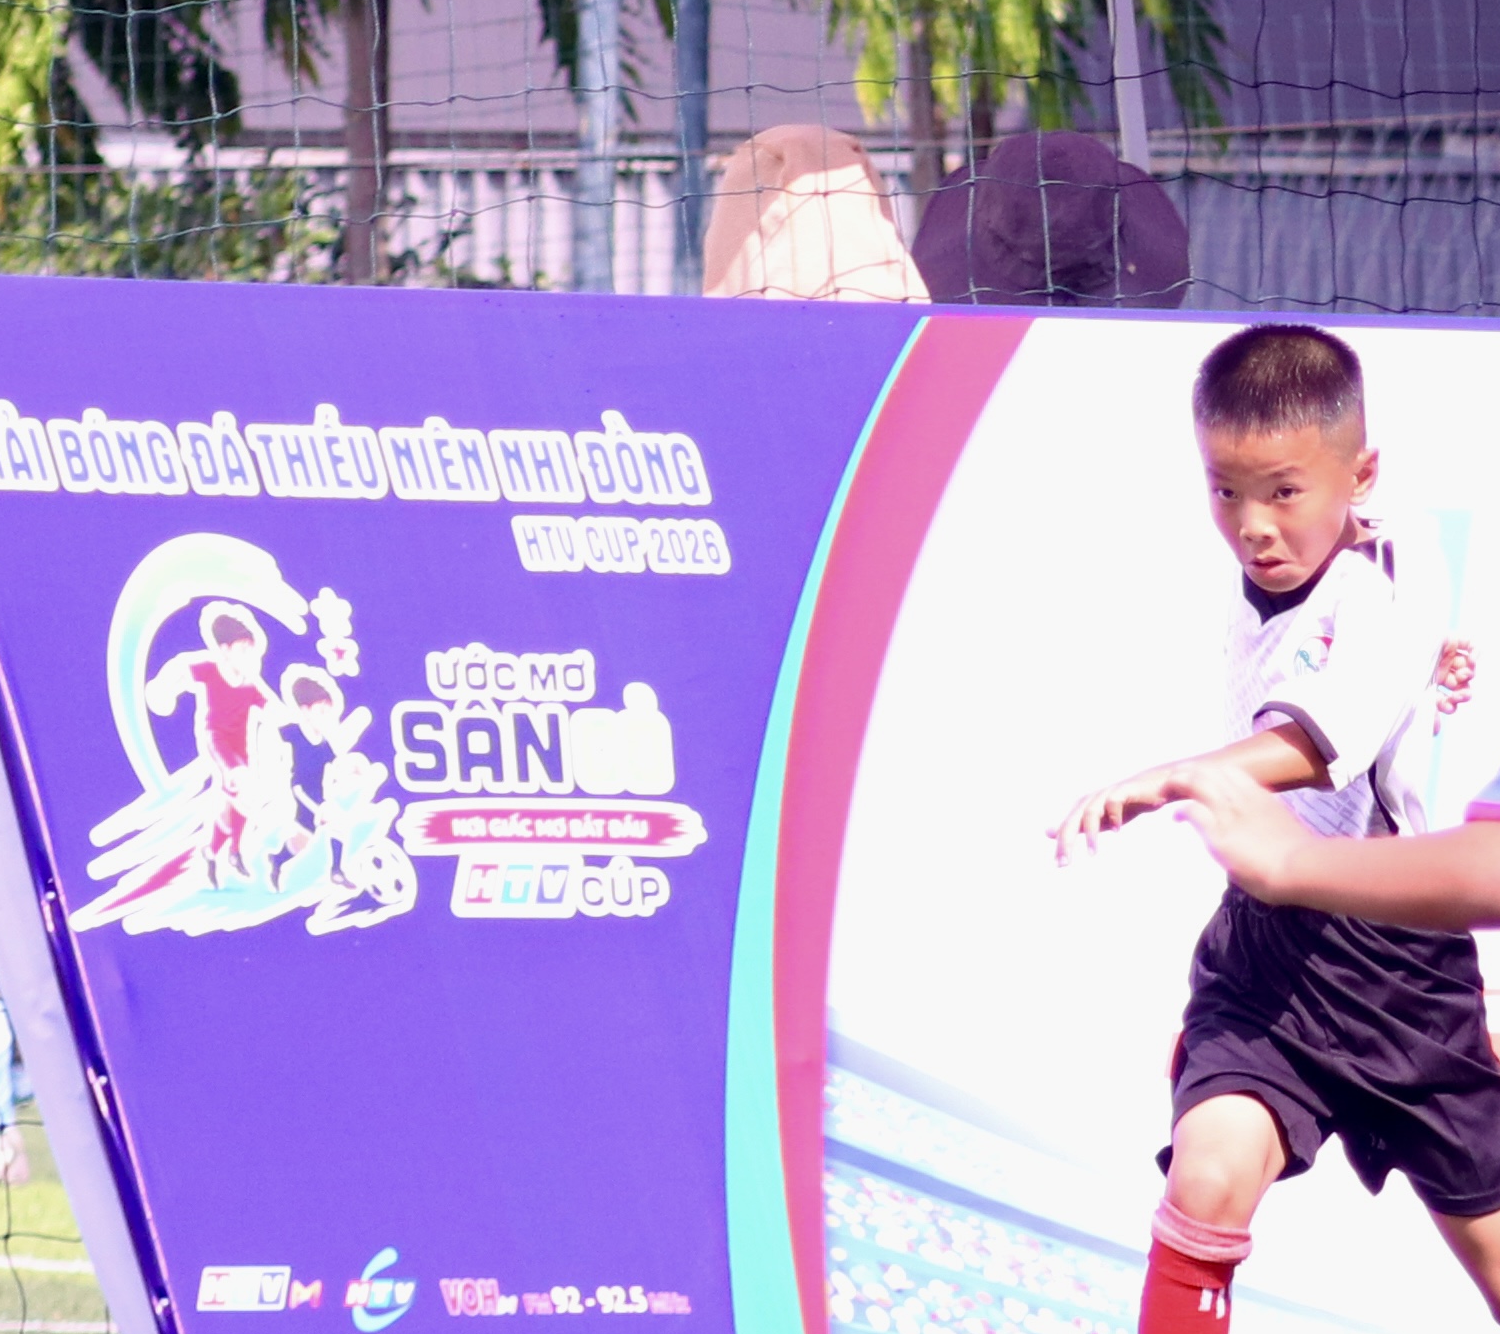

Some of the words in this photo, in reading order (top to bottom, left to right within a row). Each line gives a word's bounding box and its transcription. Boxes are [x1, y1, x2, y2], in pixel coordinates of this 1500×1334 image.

[57, 417, 178, 485] BÓNG
[187, 421, 250, 486] ĐÁ
[256, 413, 379, 488] THIẾU
[388, 427, 490, 491] NIÊN
[499, 440, 576, 492] NHI
[584, 419, 701, 495] ĐỒNG
[521, 525, 577, 562] HTV
[585, 526, 639, 562] CUP
[650, 529, 722, 565] 2026
[528, 659, 586, 692] MƠ
[399, 699, 565, 783] SÂN
[464, 864, 570, 904] HTV
[581, 865, 660, 907] CÚP
[343, 1280, 416, 1307] HTV
